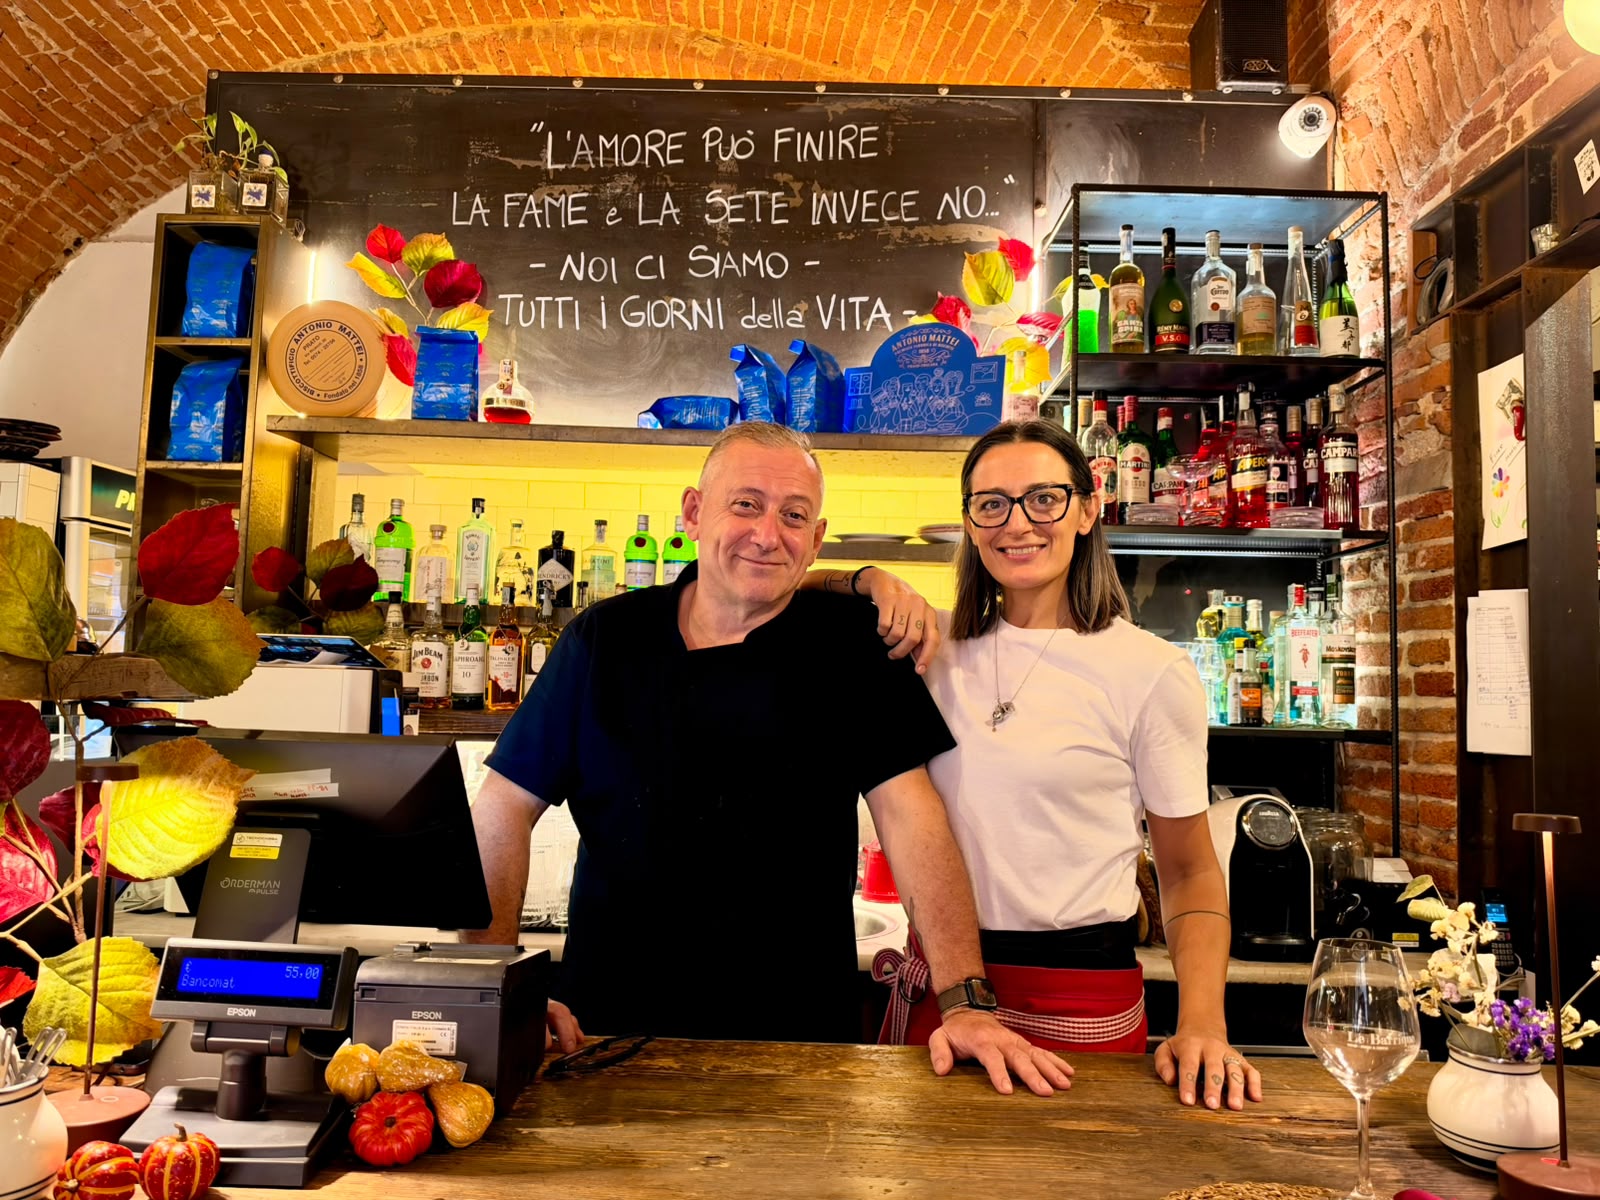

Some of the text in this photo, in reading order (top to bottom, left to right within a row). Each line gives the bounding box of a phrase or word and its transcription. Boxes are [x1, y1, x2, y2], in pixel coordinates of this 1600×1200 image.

[774, 125, 879, 162] FINIRE
[452, 191, 490, 227] LA
[504, 192, 589, 228] FAME
[606, 207, 622, 225] e
[638, 191, 680, 226] LA
[704, 189, 789, 225] SETE
[811, 189, 920, 225] INVECE
[559, 251, 618, 284] NOI
[635, 255, 665, 280] CI
[688, 245, 789, 279] SIAMO
[498, 293, 581, 331] TUTTI
[620, 294, 724, 331] GIORNI
[740, 296, 805, 330] della
[816, 293, 894, 333] VITA
[293, 321, 333, 345] ANTONIO
[338, 325, 364, 356] MATTEI
[891, 334, 927, 352] ANTONIO
[929, 333, 960, 347] MATTEI
[288, 347, 316, 396] BISCOTTIFICIO
[323, 389, 349, 399] Fondato
[1320, 447, 1358, 459] CAMPAR
[1236, 456, 1268, 472] APERO
[1291, 629, 1318, 637] BEEFEATER
[412, 649, 424, 660] JIM
[424, 646, 443, 662] BEAM
[220, 877, 281, 889] ORDERMAN
[181, 974, 236, 989] Bancomat
[226, 1007, 257, 1017] EPSON
[411, 1010, 442, 1020] EPSON
